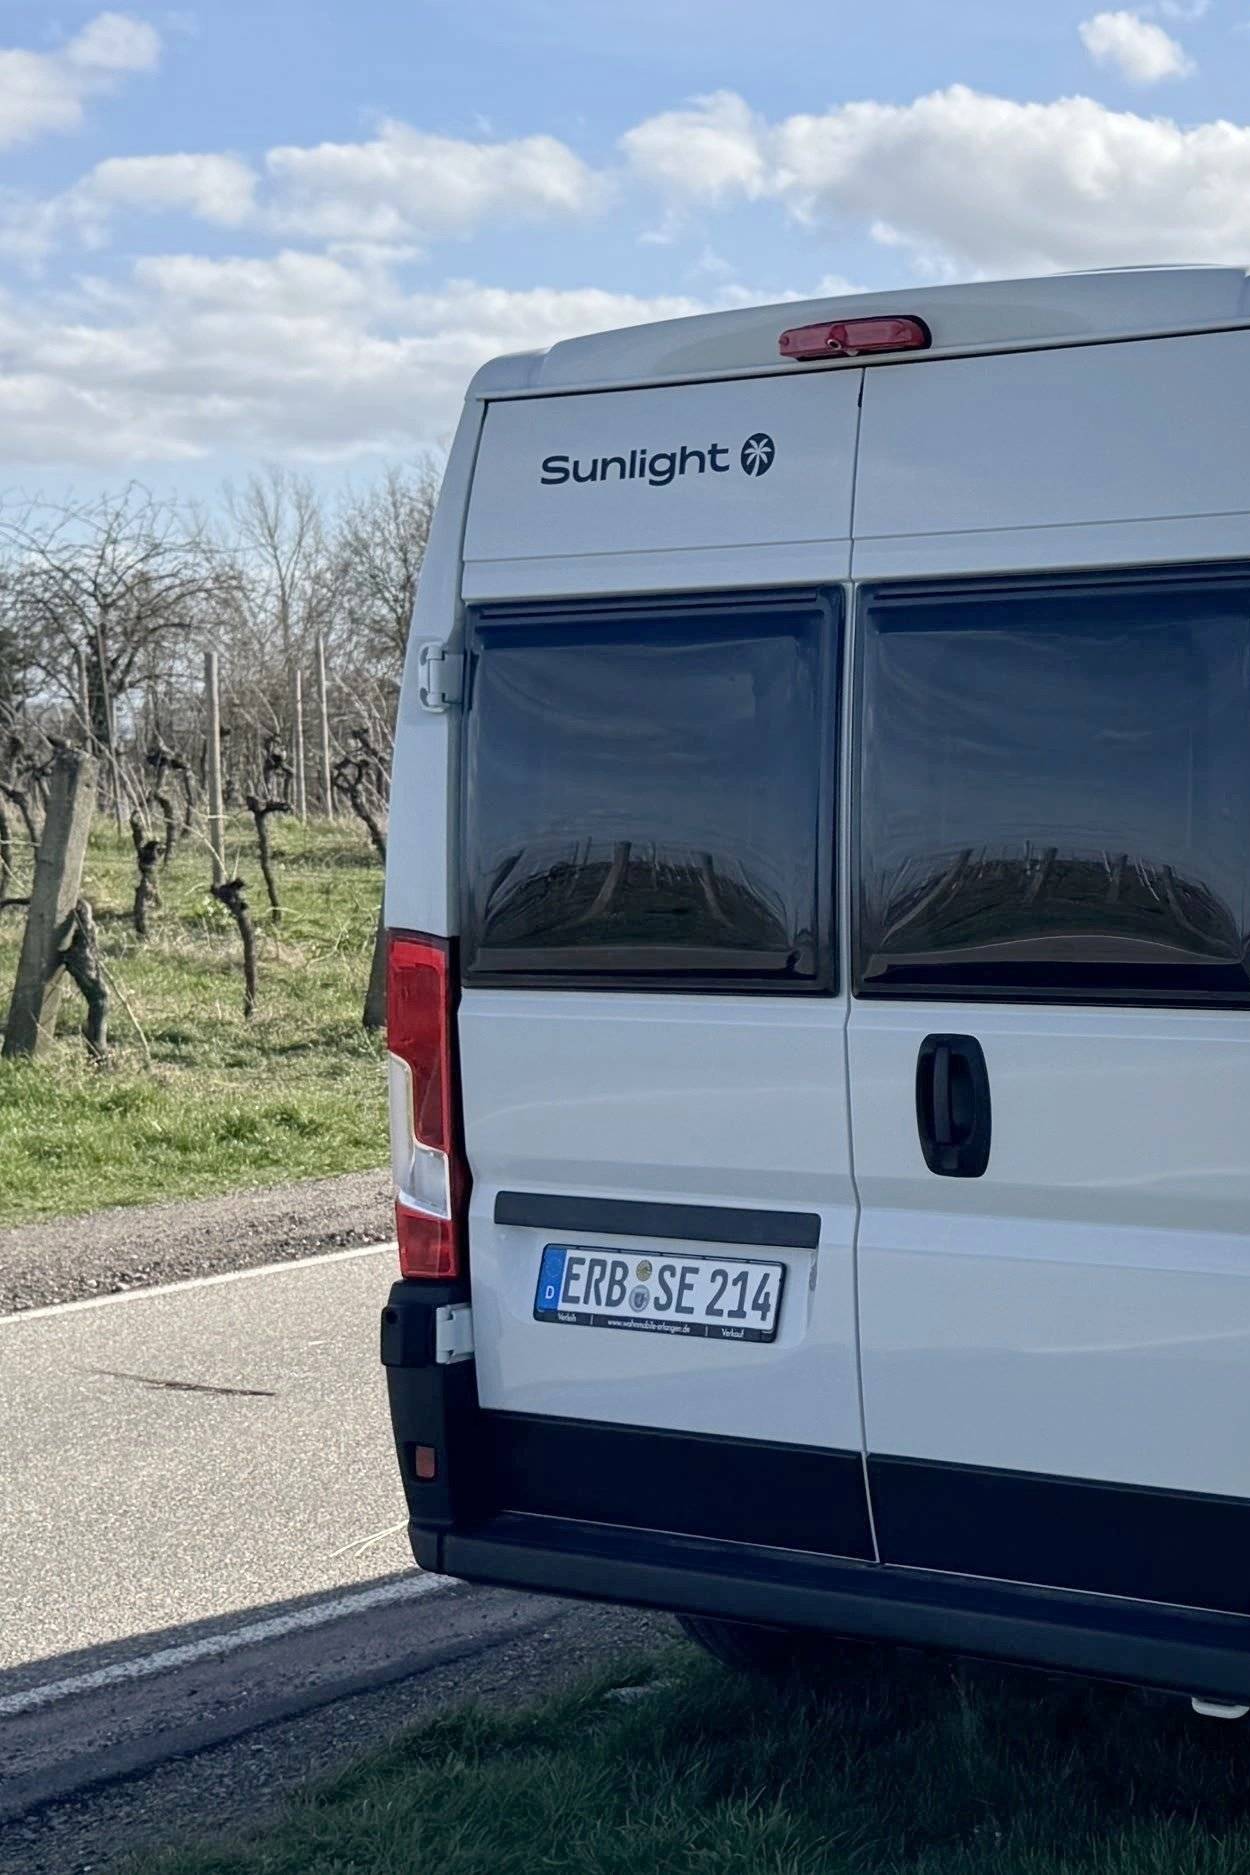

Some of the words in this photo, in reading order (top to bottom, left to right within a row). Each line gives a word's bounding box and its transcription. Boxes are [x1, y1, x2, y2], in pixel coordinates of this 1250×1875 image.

[540, 443, 730, 487] Sunlight
[544, 1285, 555, 1300] D
[561, 1256, 629, 1308] ERB
[653, 1264, 700, 1315] SE
[705, 1268, 771, 1321] 214
[721, 1328, 745, 1338] Verkauf
